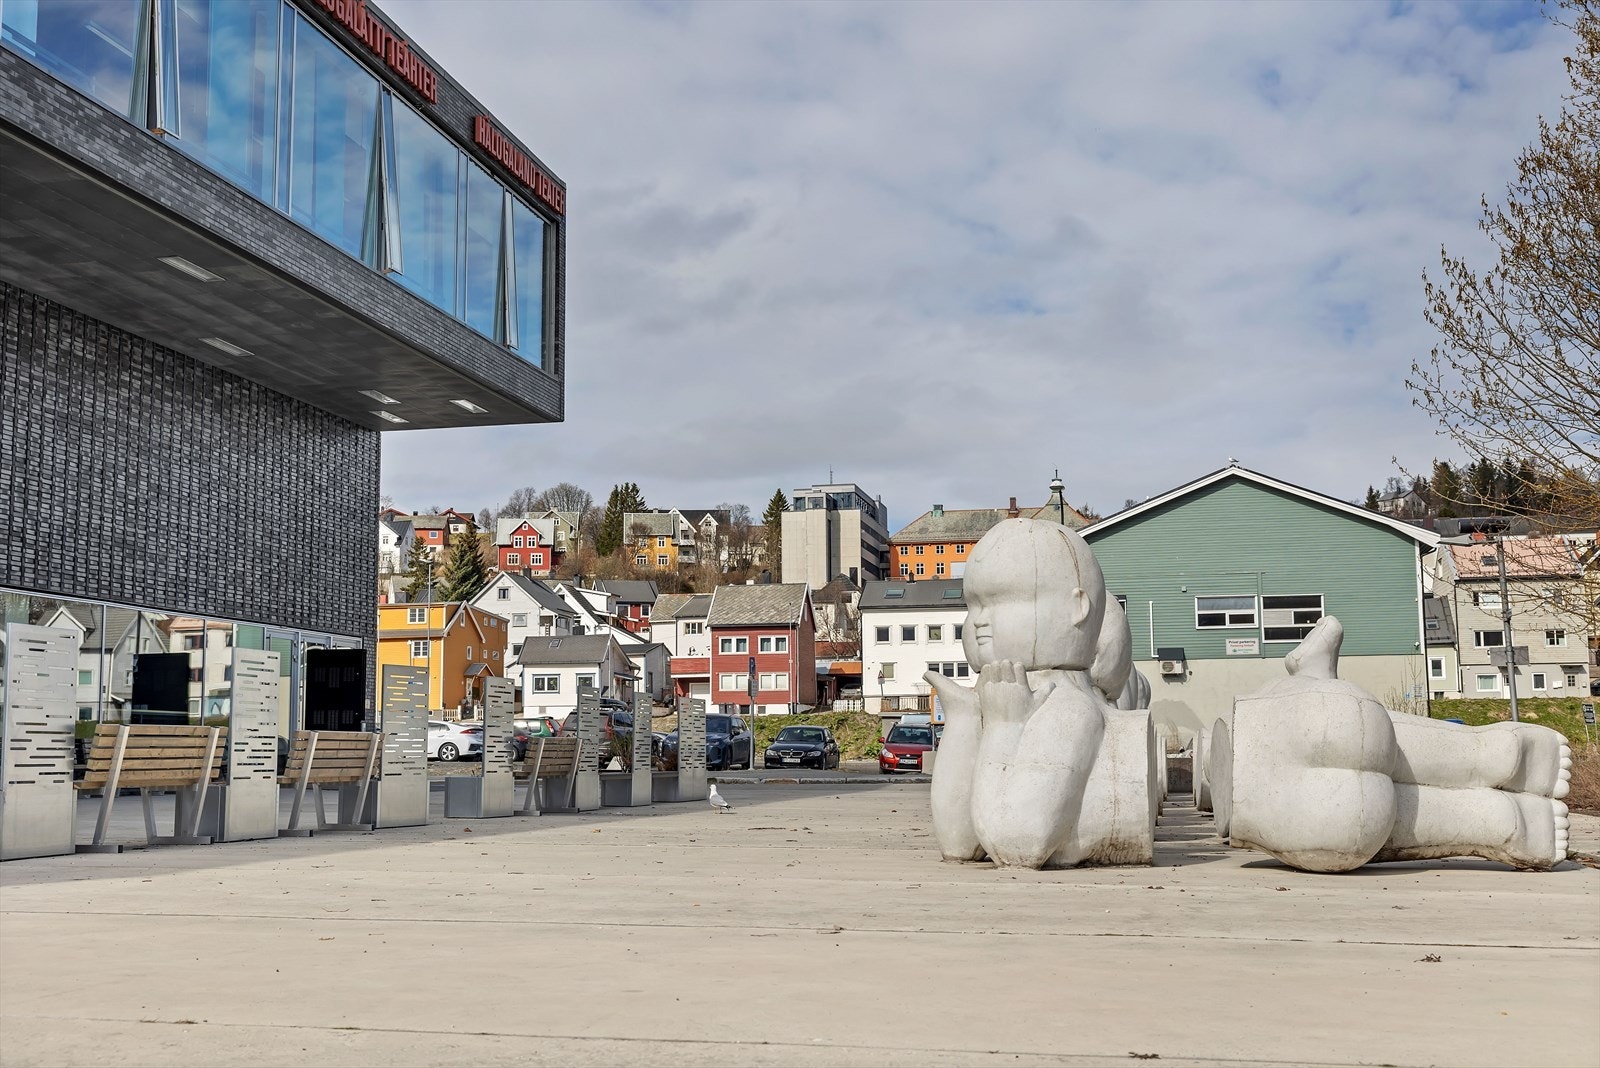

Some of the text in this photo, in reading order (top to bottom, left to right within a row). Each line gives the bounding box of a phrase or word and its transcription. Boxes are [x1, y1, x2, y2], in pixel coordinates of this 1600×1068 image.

[387, 34, 437, 104] TEÁHTER
[475, 115, 565, 216] HÅLOGALAND TEATER
